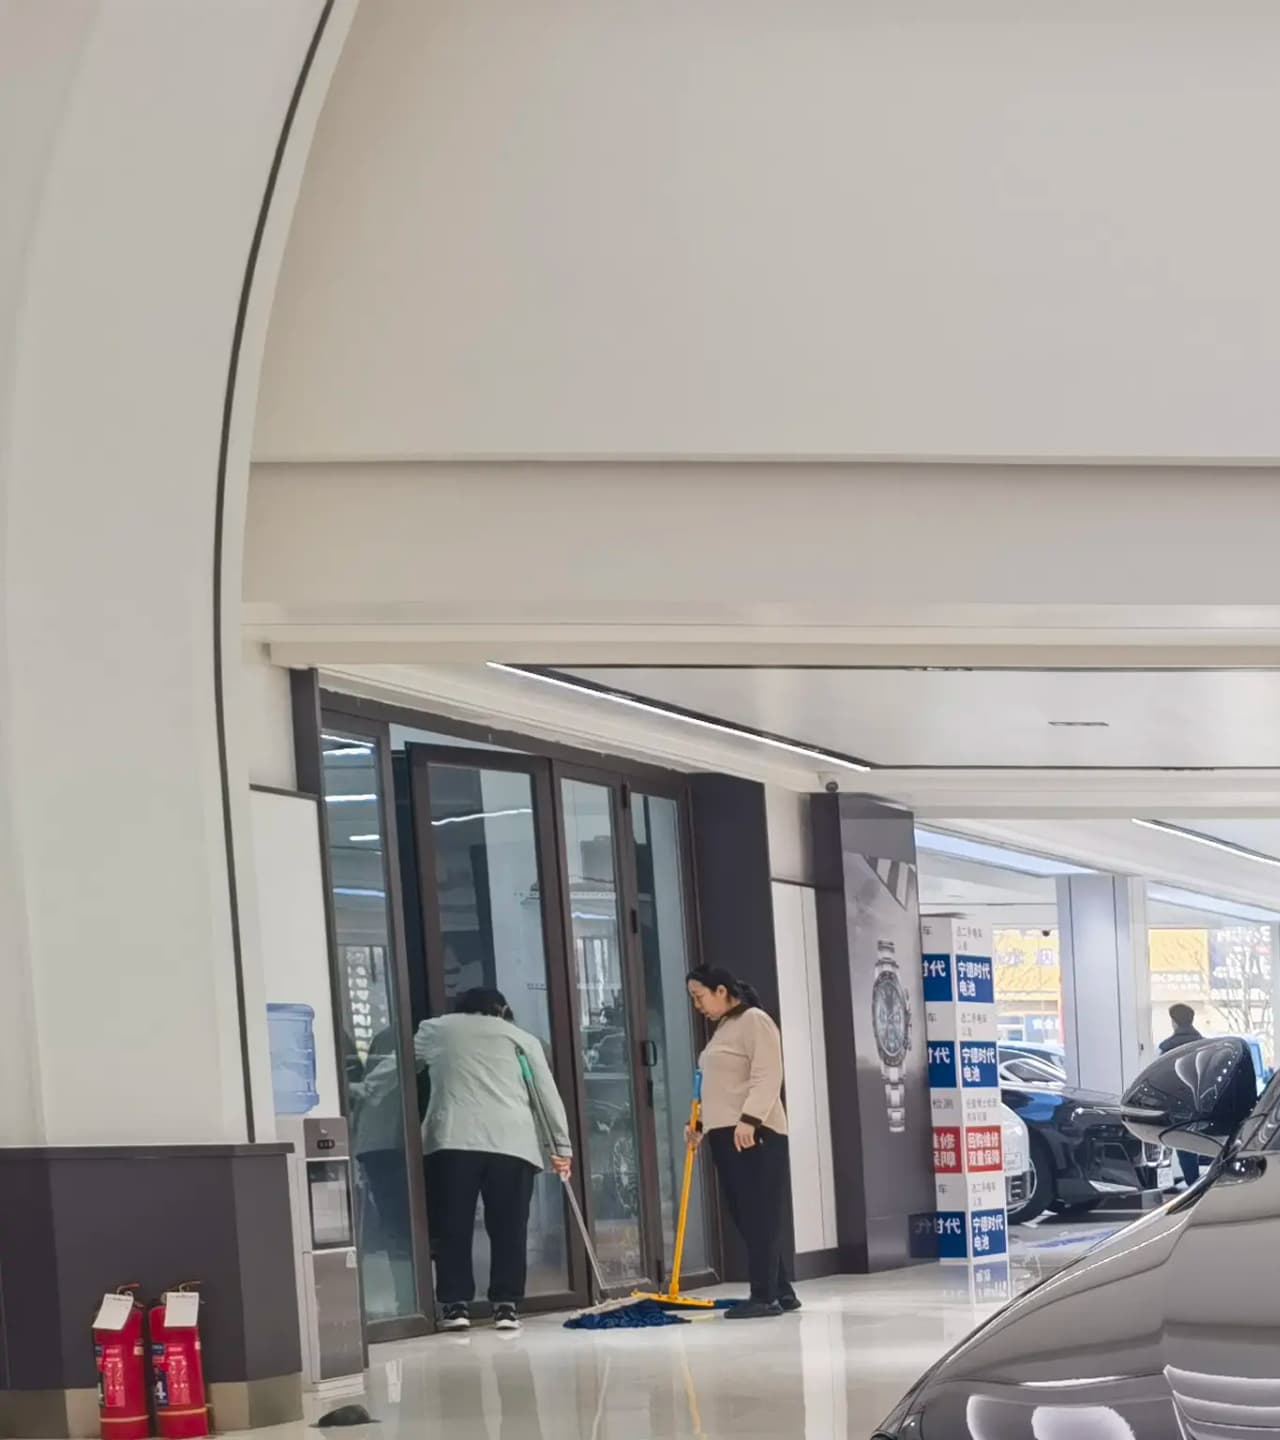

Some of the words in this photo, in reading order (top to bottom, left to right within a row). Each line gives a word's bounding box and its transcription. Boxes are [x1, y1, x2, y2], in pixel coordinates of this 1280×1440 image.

[958, 960, 991, 979] 宁德时代
[960, 980, 977, 997] 电池
[961, 1046, 995, 1064] 宁德时代
[963, 1065, 981, 1082] 电池
[972, 1214, 1003, 1233] 宁德时代
[973, 1234, 990, 1251] 电池
